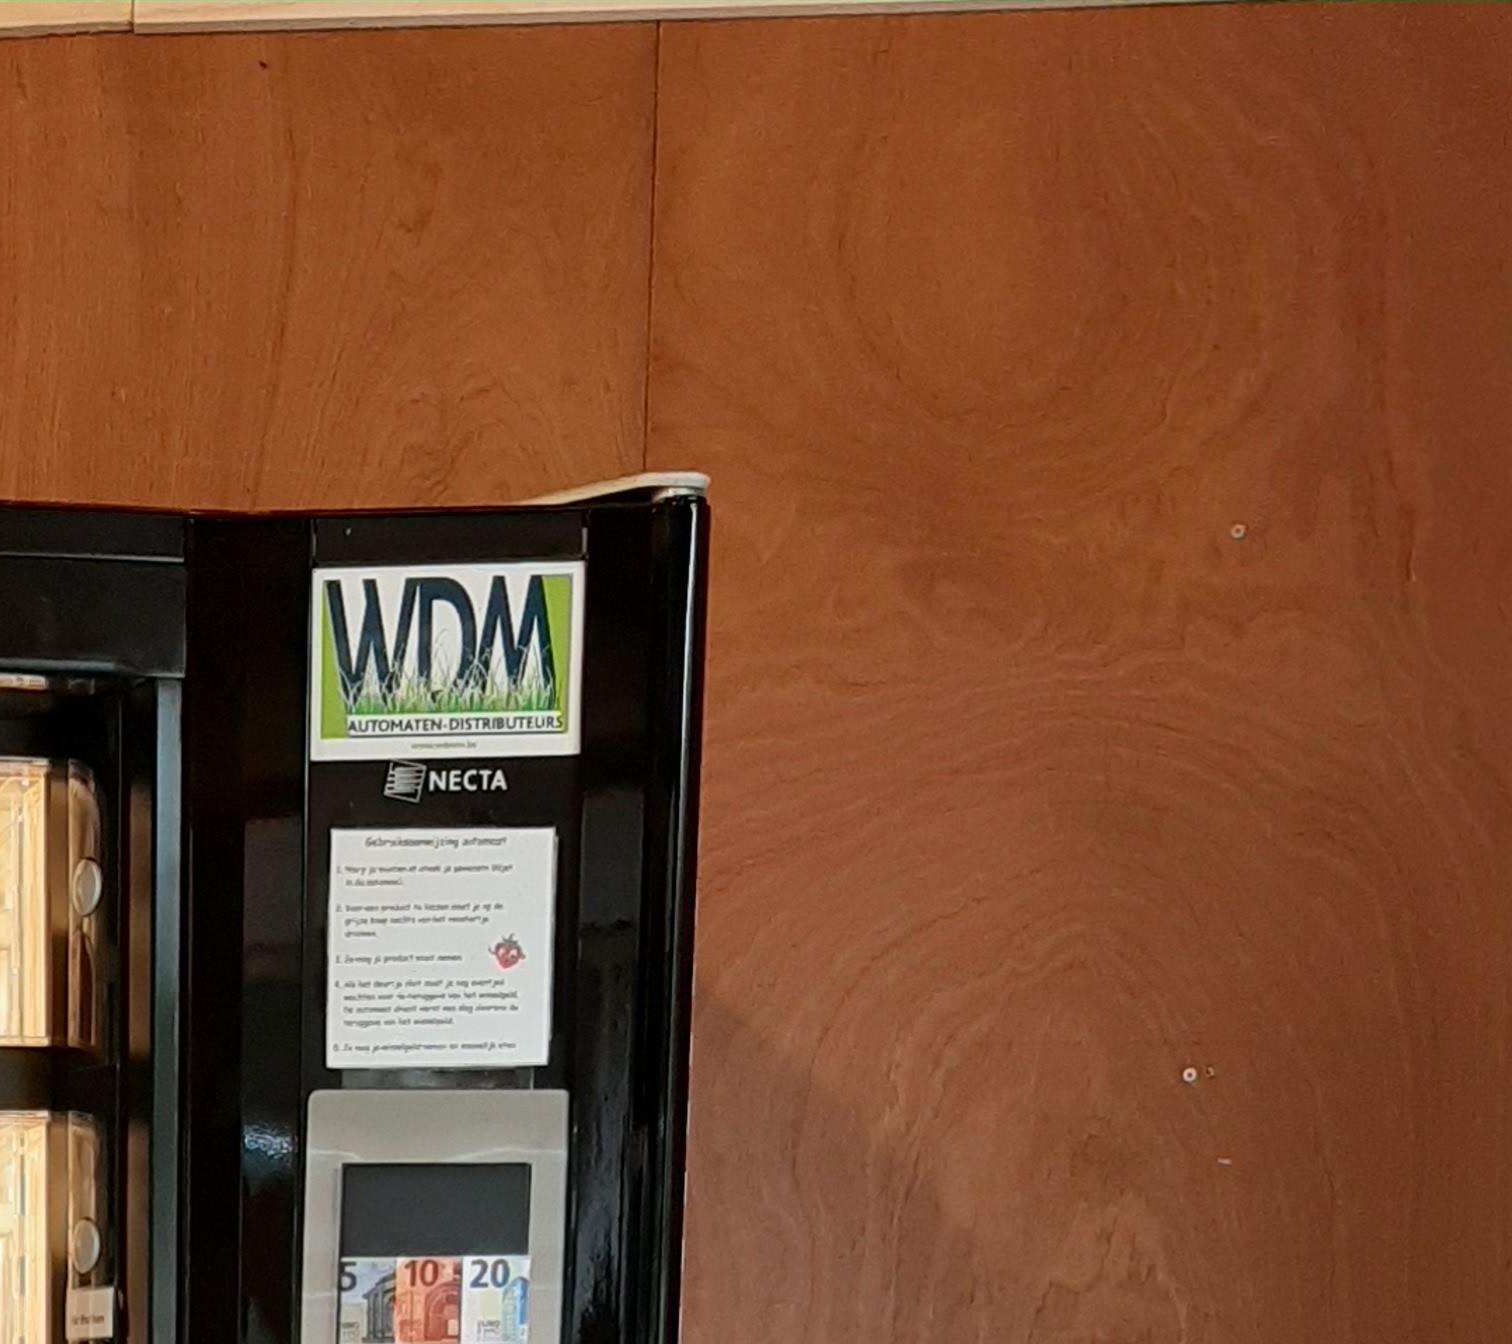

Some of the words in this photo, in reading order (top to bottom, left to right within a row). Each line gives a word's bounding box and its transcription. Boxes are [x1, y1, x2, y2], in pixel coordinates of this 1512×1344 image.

[325, 574, 557, 708] WDM
[348, 714, 564, 734] AUTOMATEN-DISTRIBUTEURS
[428, 769, 508, 792] NECTA
[339, 1260, 357, 1292] 5
[404, 1259, 438, 1288] 10
[470, 1258, 510, 1289] 20
